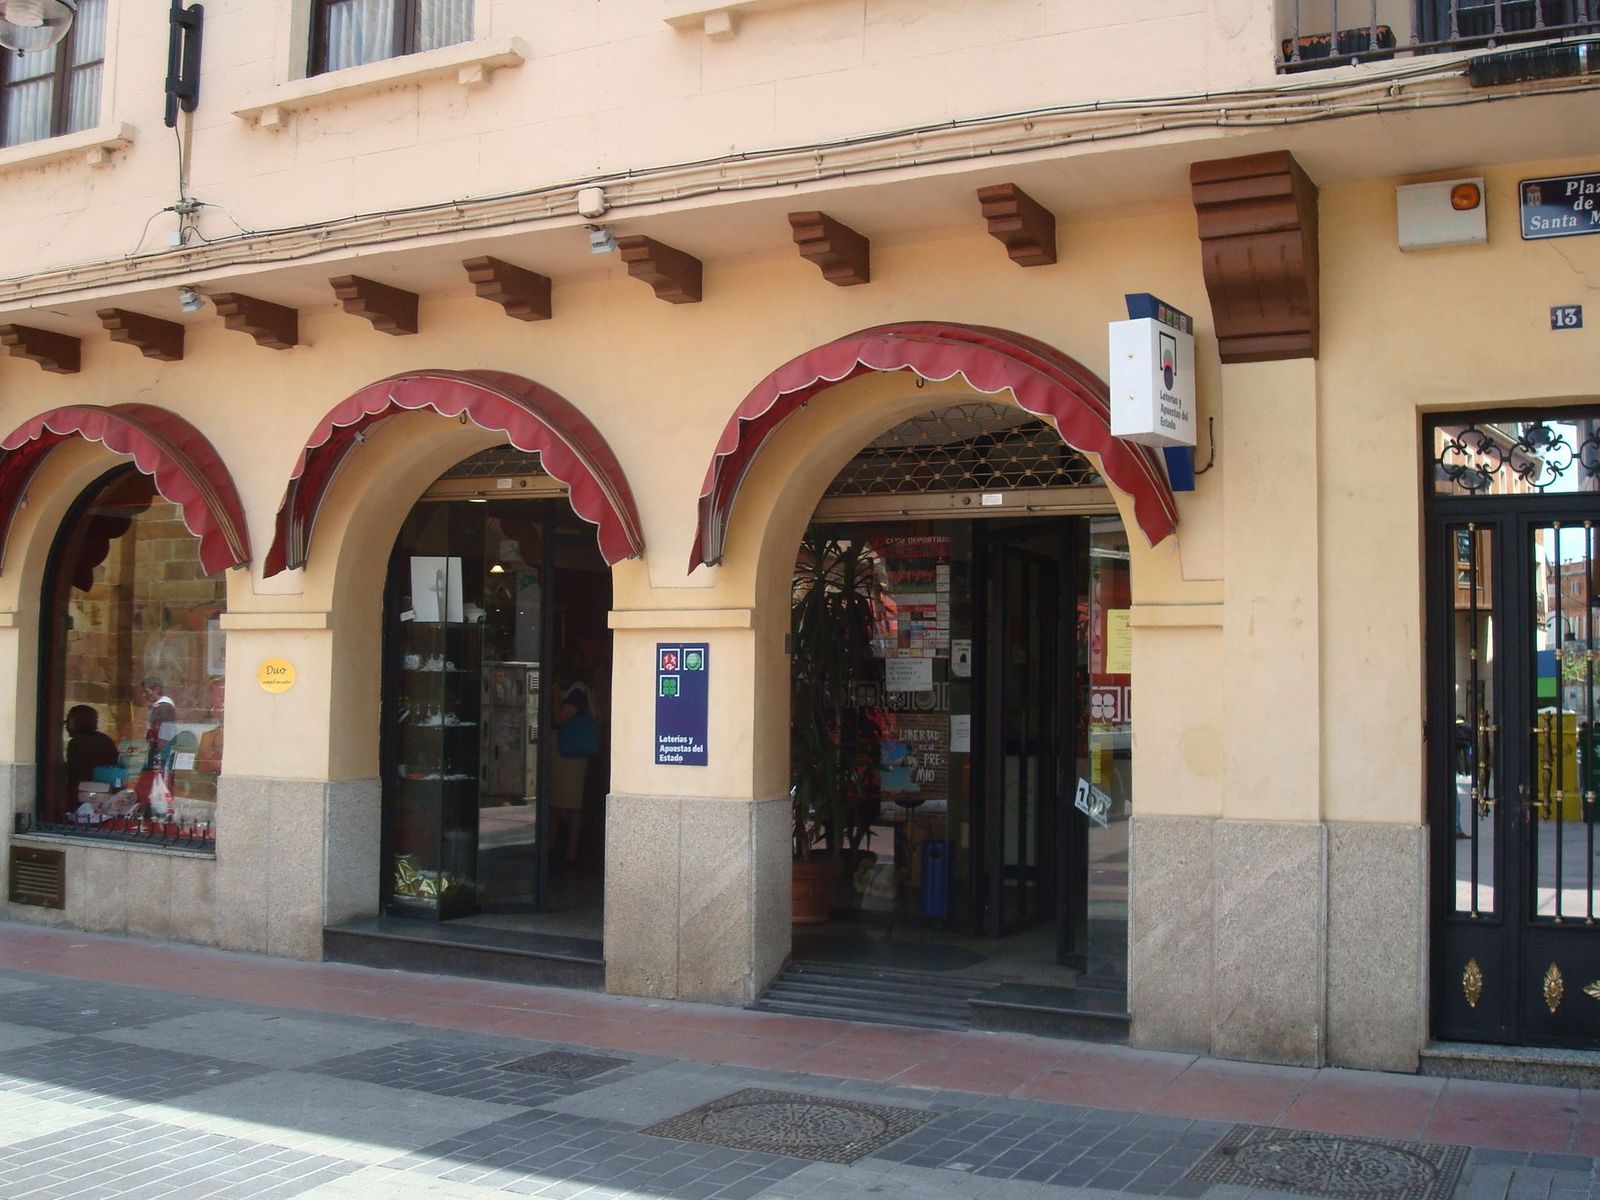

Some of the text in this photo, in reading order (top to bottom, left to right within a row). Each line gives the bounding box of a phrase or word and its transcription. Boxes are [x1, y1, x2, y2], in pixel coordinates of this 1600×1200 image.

[1573, 195, 1594, 211] de
[1530, 214, 1577, 231] Santa
[1556, 308, 1577, 326] 13
[1160, 403, 1181, 419] Apuestas
[1160, 416, 1176, 430] Estado
[265, 665, 287, 675] Duo
[659, 734, 694, 745] Loterías y
[899, 729, 941, 741] LIBERTAD
[659, 744, 704, 754] Apuestas del
[659, 753, 684, 762] Estado
